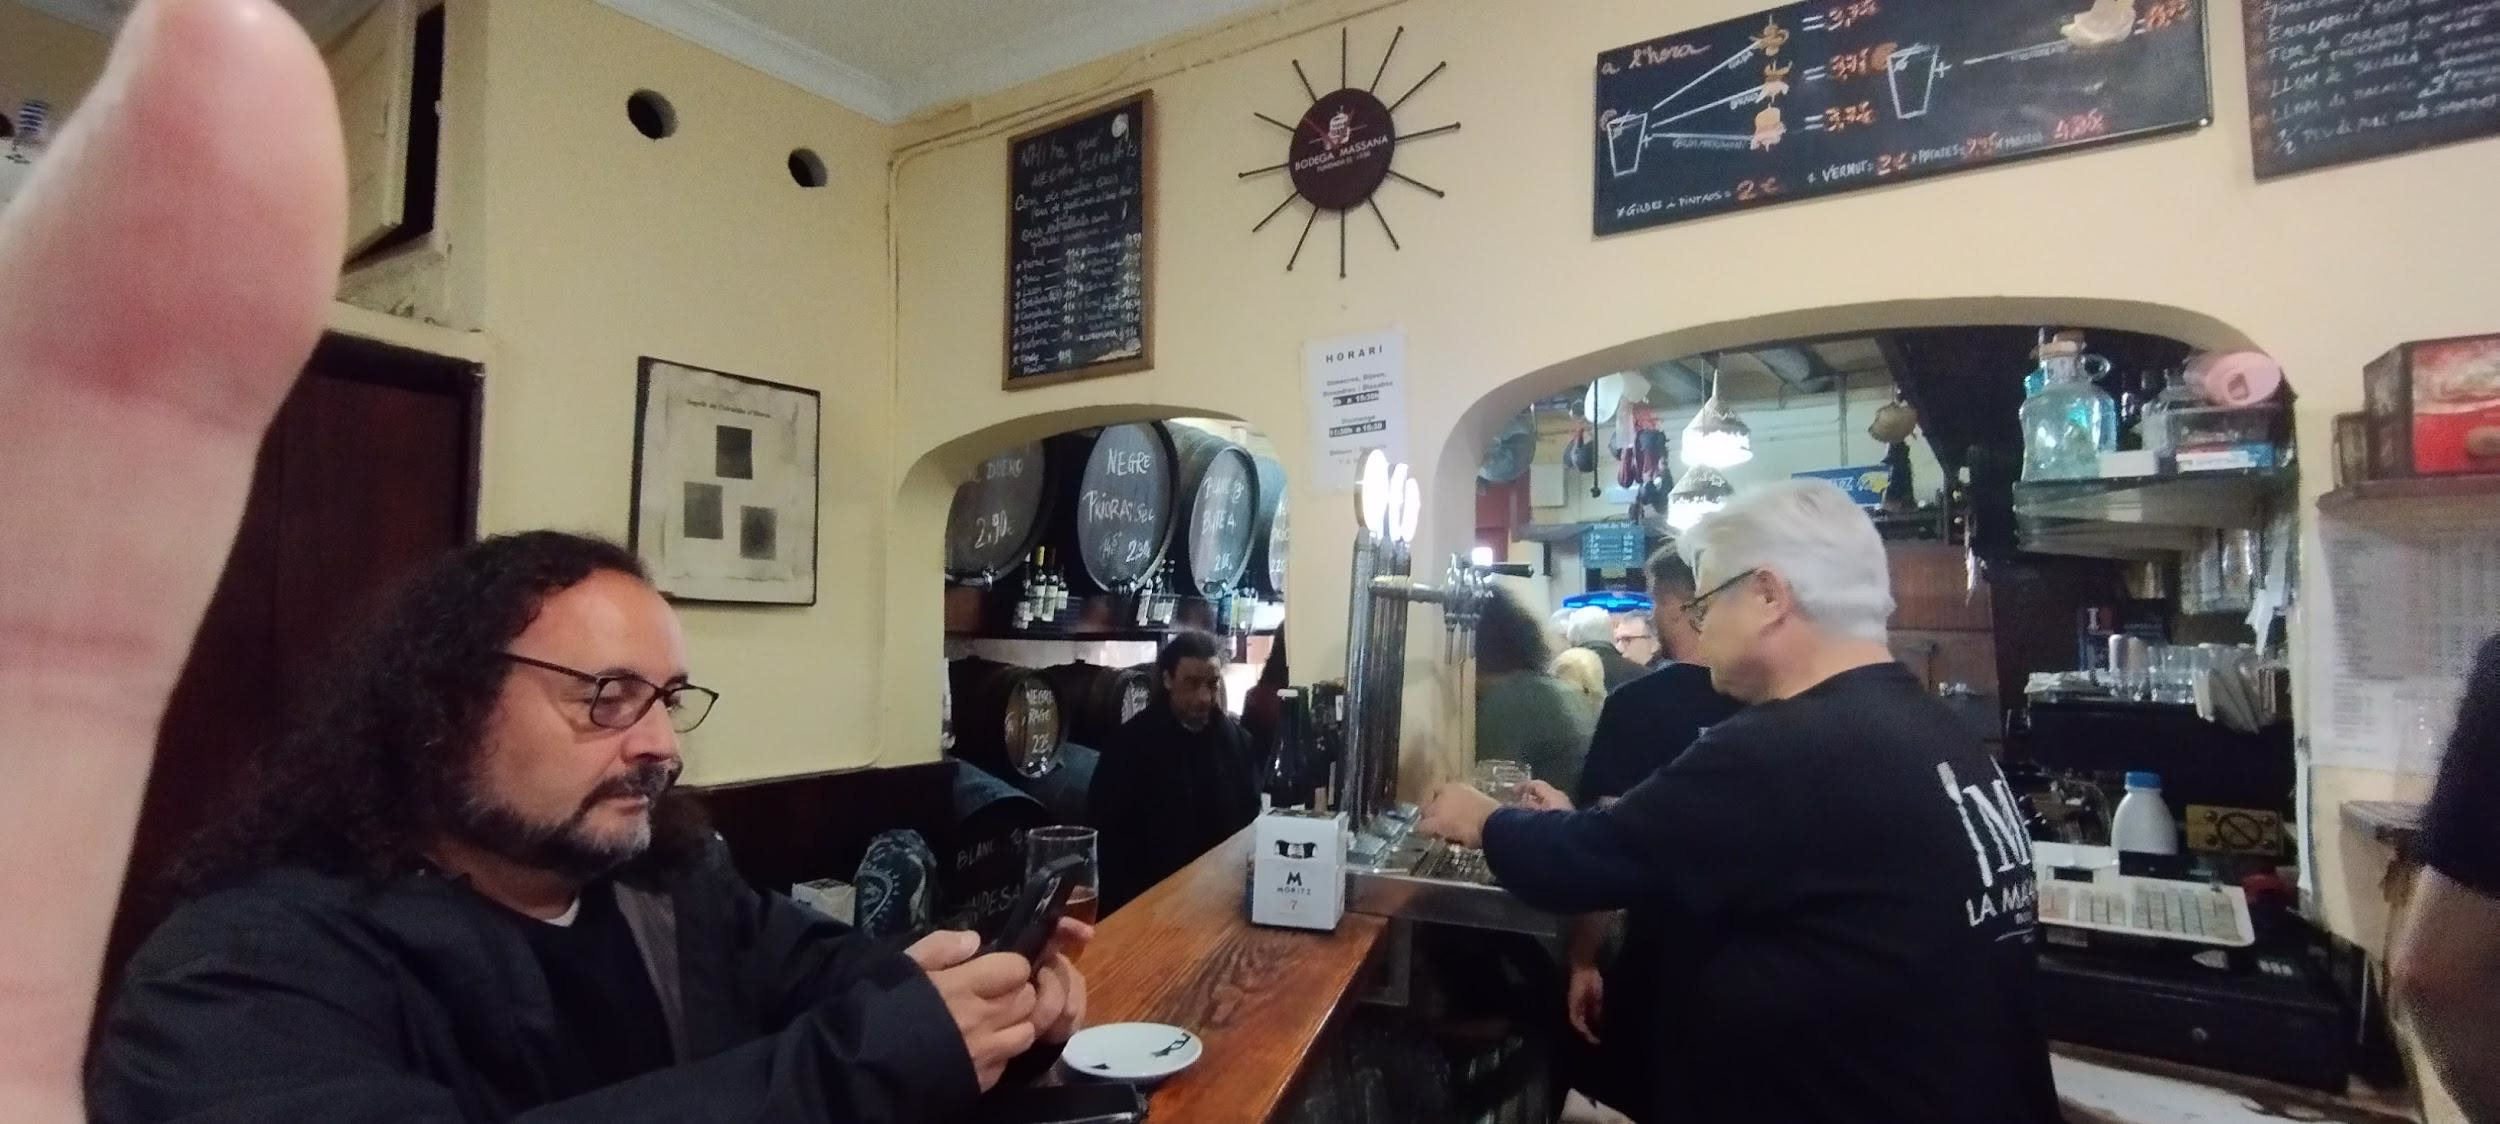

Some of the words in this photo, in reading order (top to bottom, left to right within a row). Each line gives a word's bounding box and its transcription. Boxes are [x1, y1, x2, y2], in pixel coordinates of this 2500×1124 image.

[1295, 153, 1334, 171] BODEGA
[1339, 135, 1388, 156] MASSANA
[1326, 345, 1383, 363] HORARI
[1276, 886, 1311, 896] MORITZ
[1287, 871, 1302, 886] M
[971, 884, 1021, 917] NDESA
[1966, 892, 1998, 927] LA
